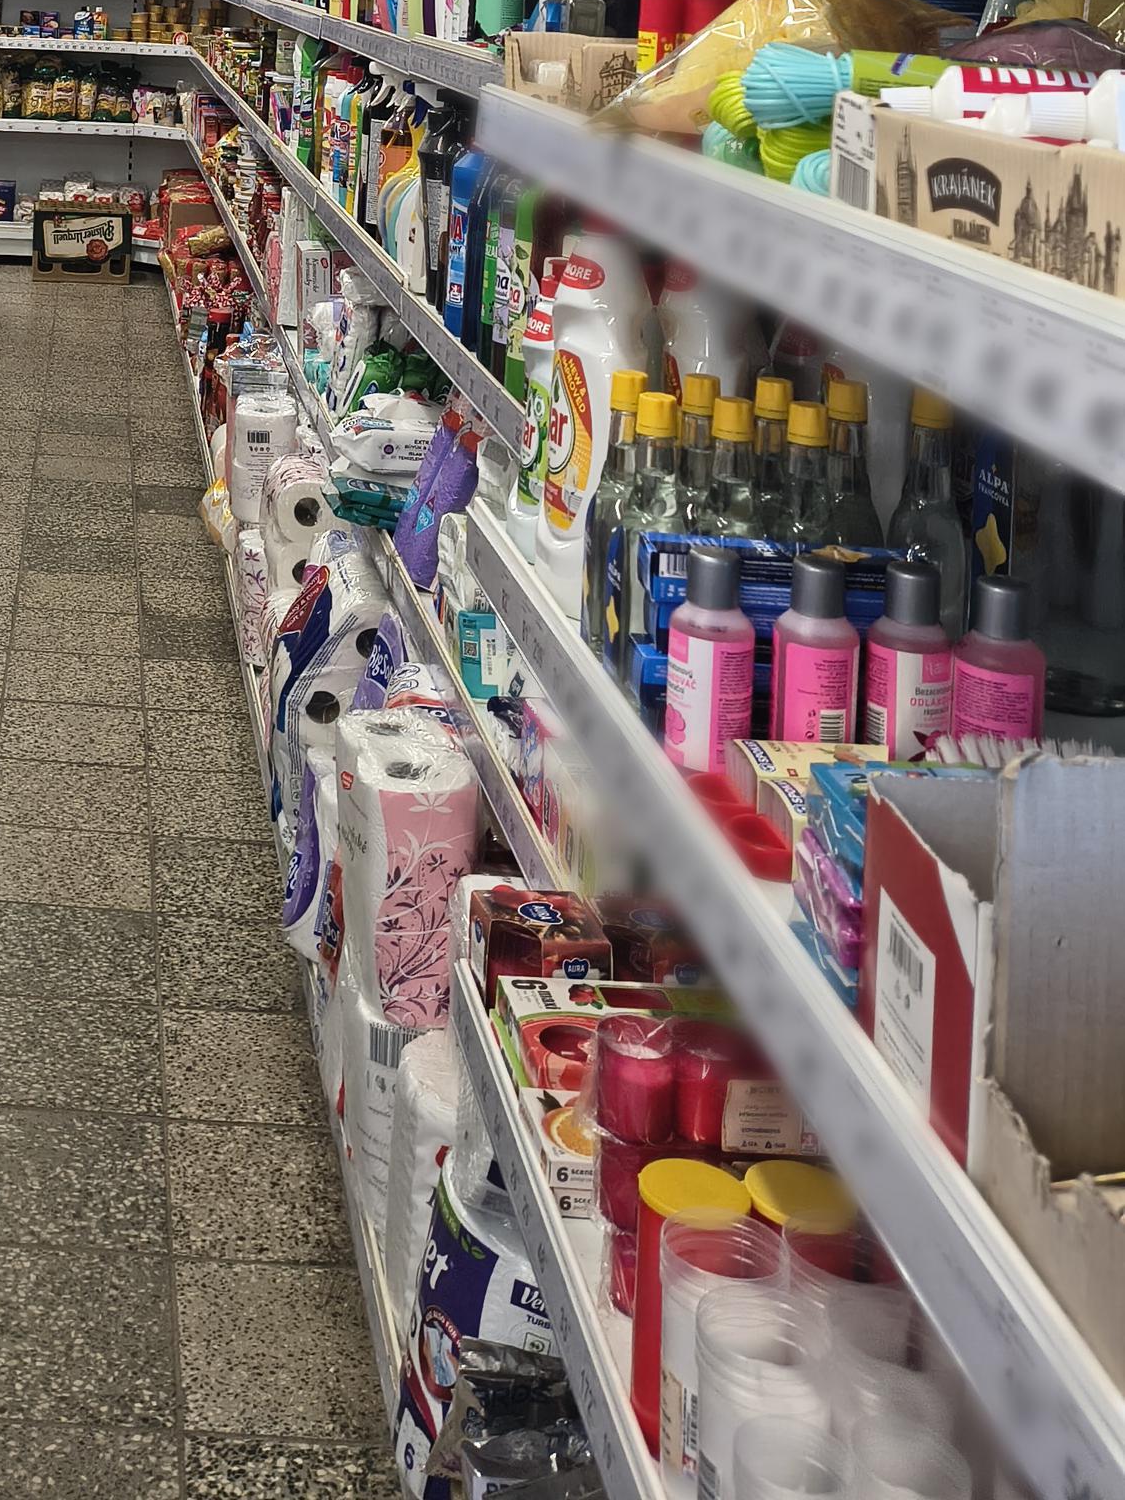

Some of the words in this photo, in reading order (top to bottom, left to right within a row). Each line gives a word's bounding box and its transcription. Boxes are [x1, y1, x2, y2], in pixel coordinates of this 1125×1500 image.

[931, 167, 996, 211] KRAJÁNEK
[561, 355, 586, 413] IMPROVED
[566, 357, 583, 387] NEW
[579, 386, 587, 398] &
[979, 466, 1010, 495] ALPA
[567, 963, 586, 974] AURA
[511, 978, 547, 991] 6
[556, 1167, 569, 1183] 6
[571, 1168, 594, 1177] scent
[559, 1194, 572, 1211] 6
[423, 1236, 451, 1292] et
[404, 1442, 416, 1469] 6
